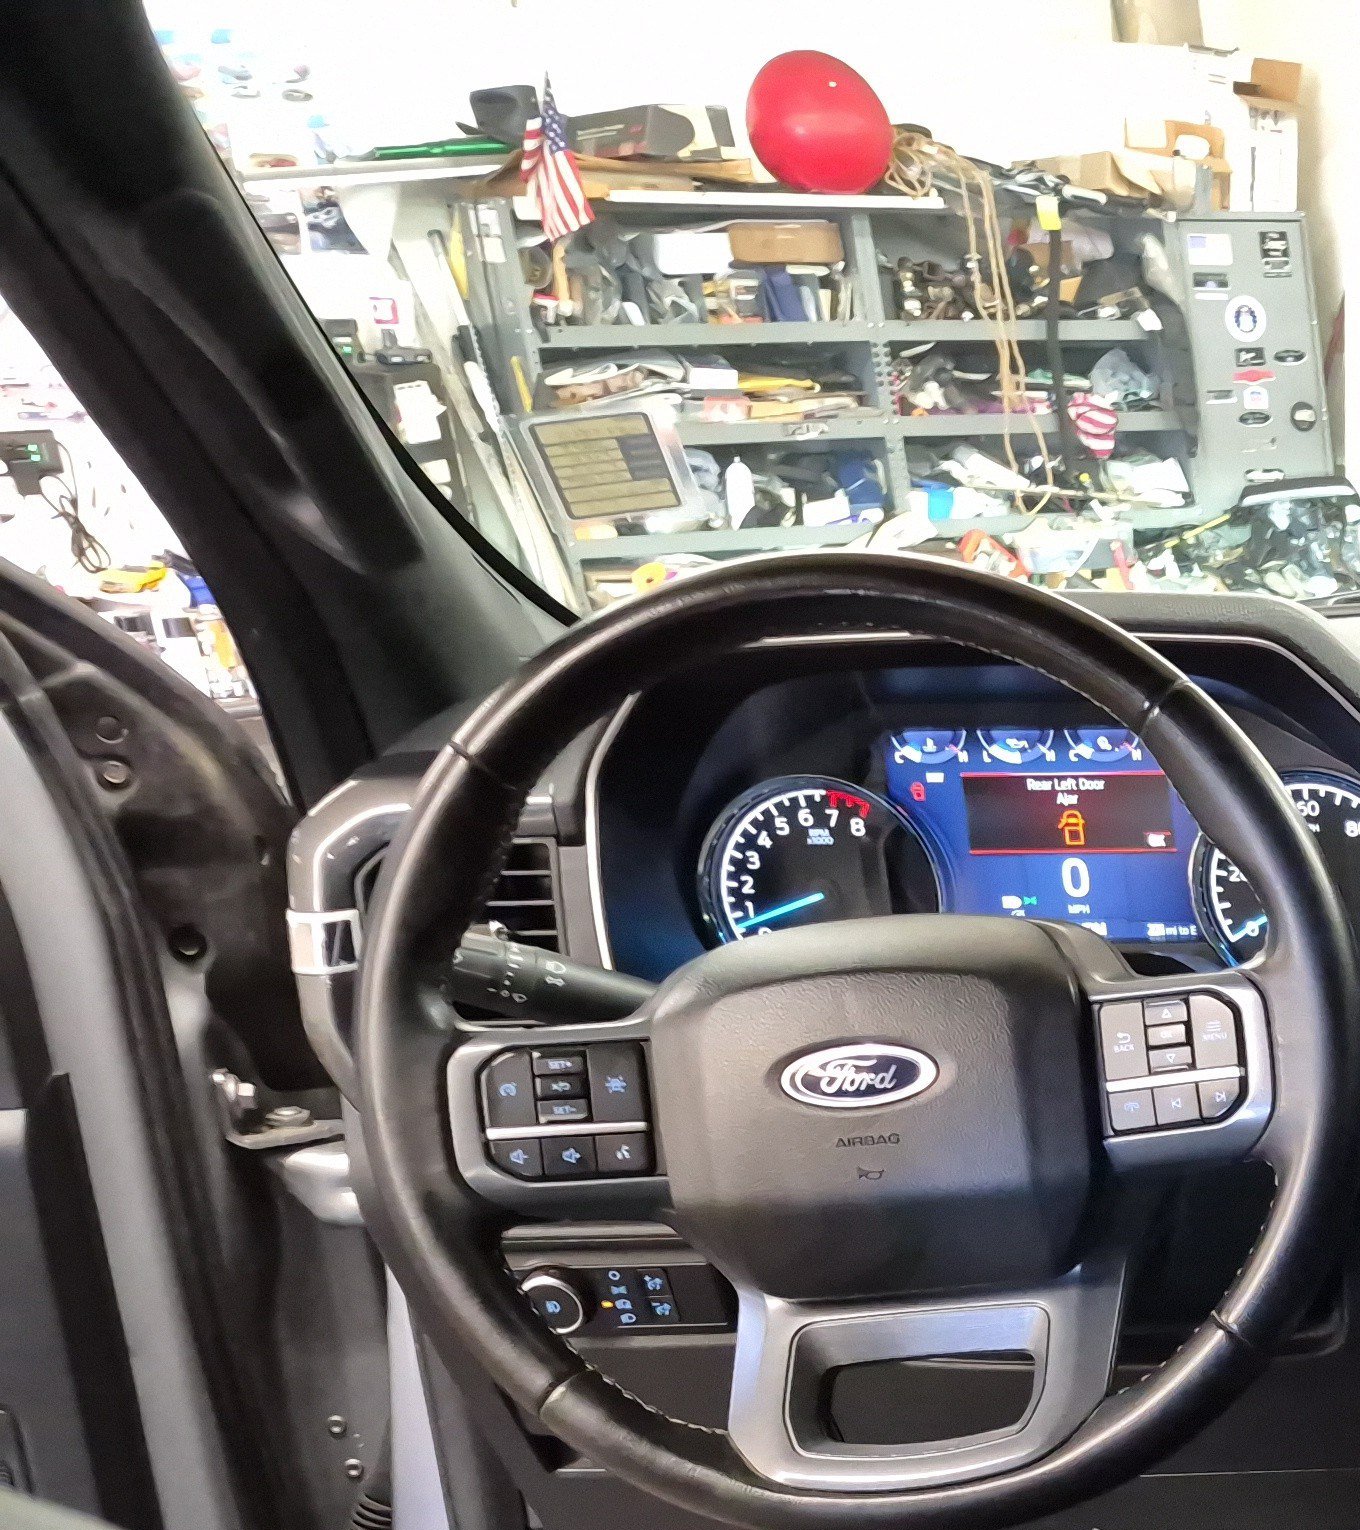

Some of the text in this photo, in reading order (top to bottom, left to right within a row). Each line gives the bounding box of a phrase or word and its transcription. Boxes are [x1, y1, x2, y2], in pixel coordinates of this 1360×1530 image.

[1026, 778, 1105, 791] Rear Left Door
[1056, 793, 1079, 806] Ajar
[774, 817, 790, 836] 5
[798, 808, 814, 827] 6
[824, 808, 840, 827] 7
[850, 817, 866, 837] 8
[757, 830, 773, 848] 4
[745, 851, 761, 869] 3
[740, 875, 756, 894] 2
[1061, 857, 1090, 898] 0
[744, 901, 756, 919] 1
[1067, 904, 1091, 915] MPH
[1202, 1032, 1227, 1042] MENU
[1113, 1044, 1135, 1053] BACK
[799, 1058, 898, 1094] Ford
[835, 1132, 900, 1149] AIRBAG
